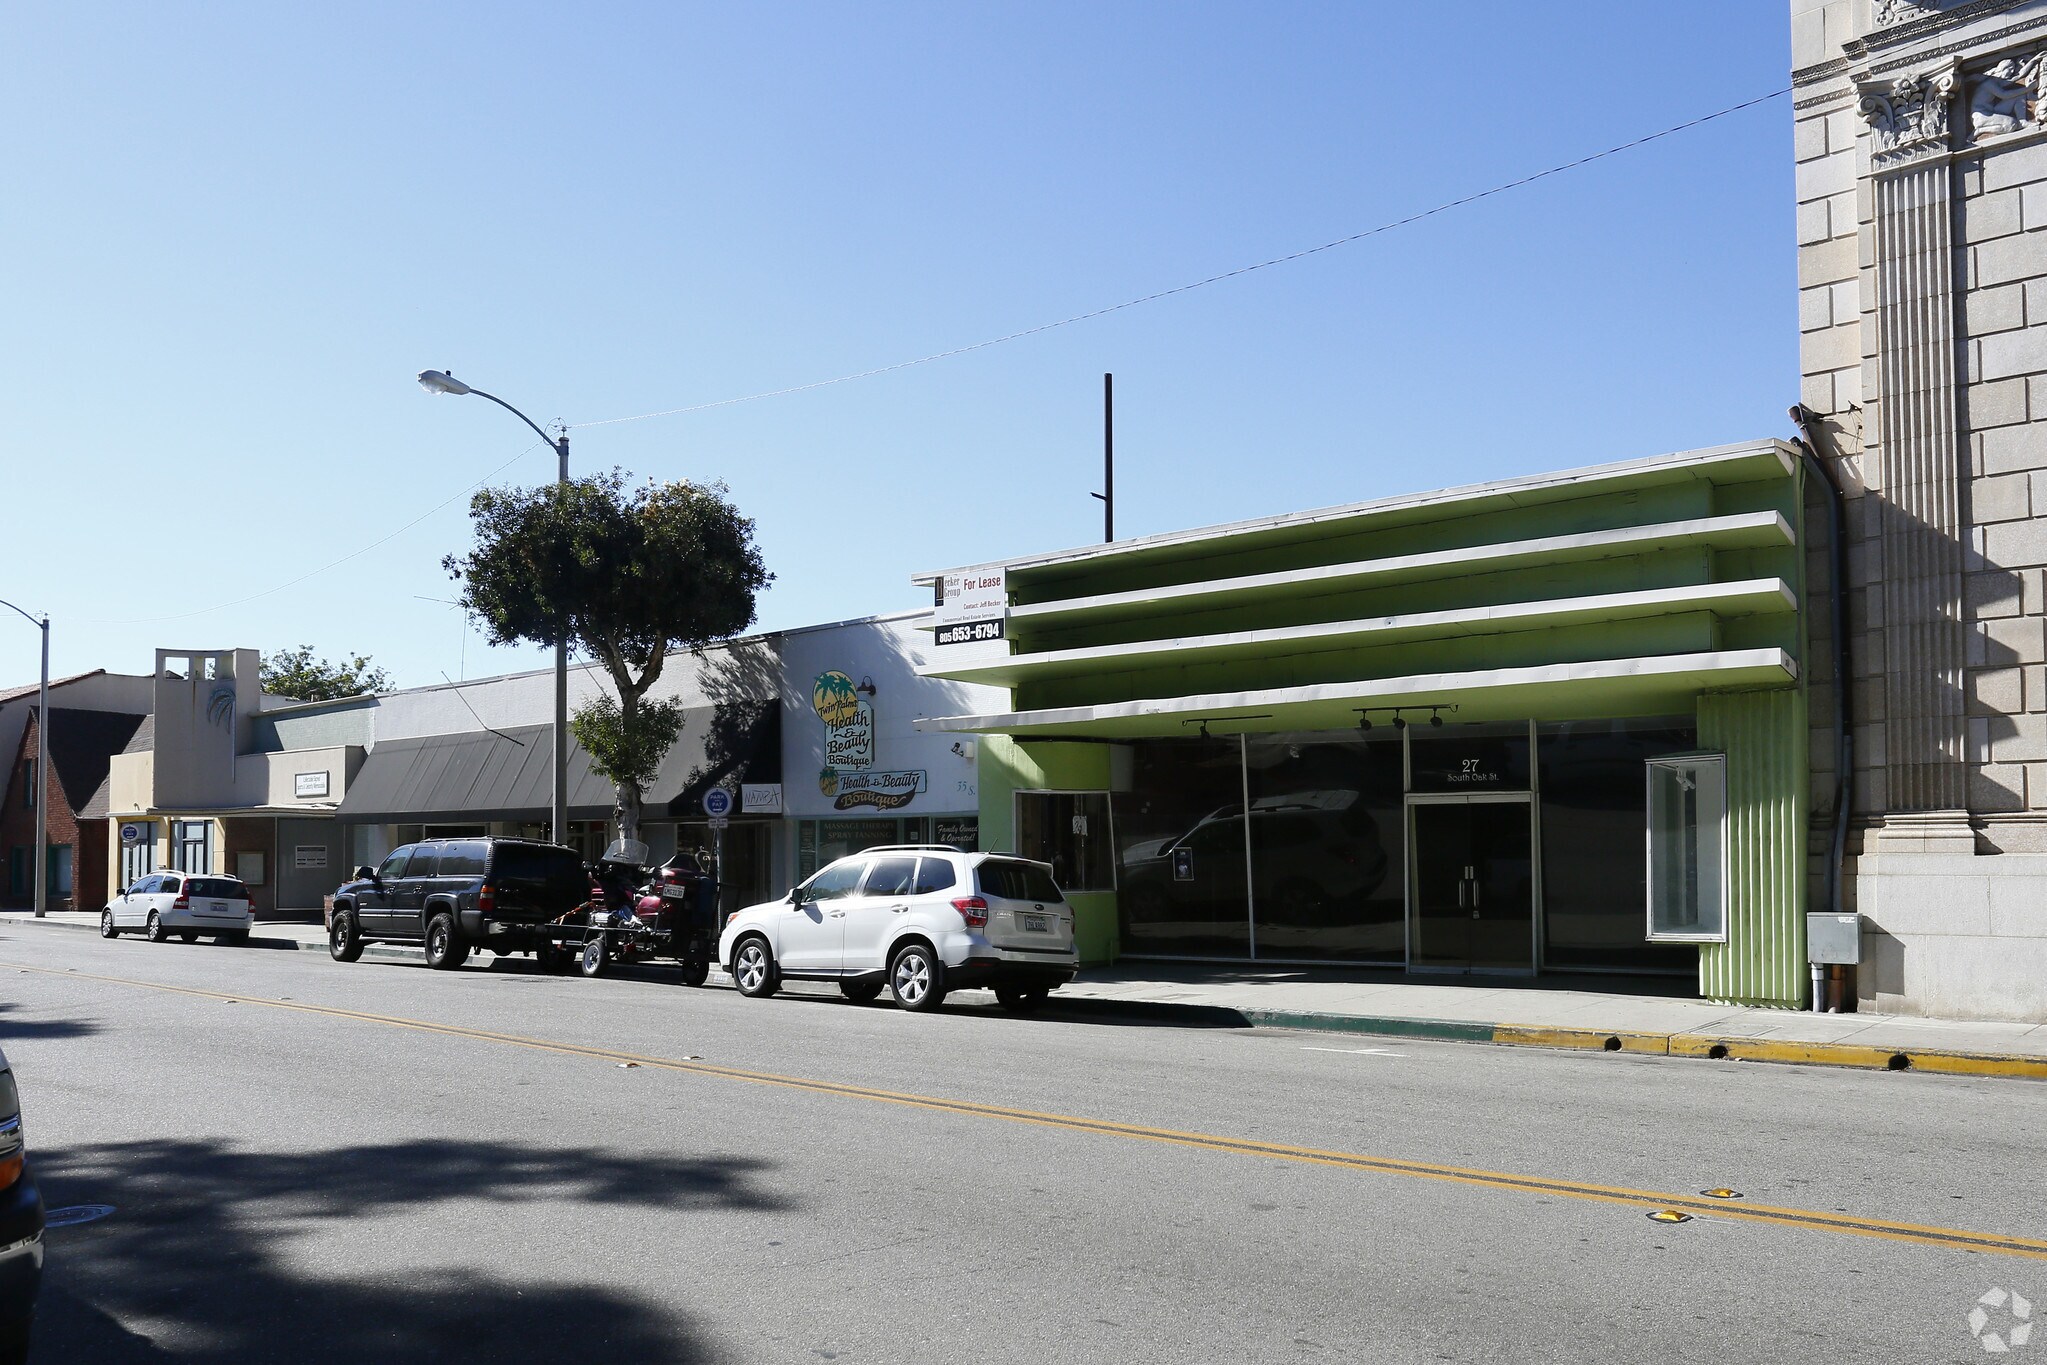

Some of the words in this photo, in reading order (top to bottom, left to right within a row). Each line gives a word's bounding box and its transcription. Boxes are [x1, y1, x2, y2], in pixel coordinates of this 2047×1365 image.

[964, 579, 975, 590] For
[979, 576, 1001, 588] Lease
[944, 588, 960, 598] Group
[940, 632, 952, 643] 805
[952, 622, 999, 642] 653-6794
[818, 702, 835, 716] Twin
[836, 698, 858, 708] Palms
[827, 710, 870, 734] Health
[827, 732, 870, 754] Beauty
[827, 755, 870, 770] Boutique
[1462, 759, 1480, 773] 27
[841, 775, 870, 790] Health
[882, 772, 920, 788] Beauty
[1447, 773, 1470, 782] South
[1471, 773, 1488, 781] Oak
[957, 781, 967, 791] 35
[841, 791, 906, 811] Boutique
[824, 821, 859, 830] MASSAGE
[828, 831, 852, 840] SPRAY
